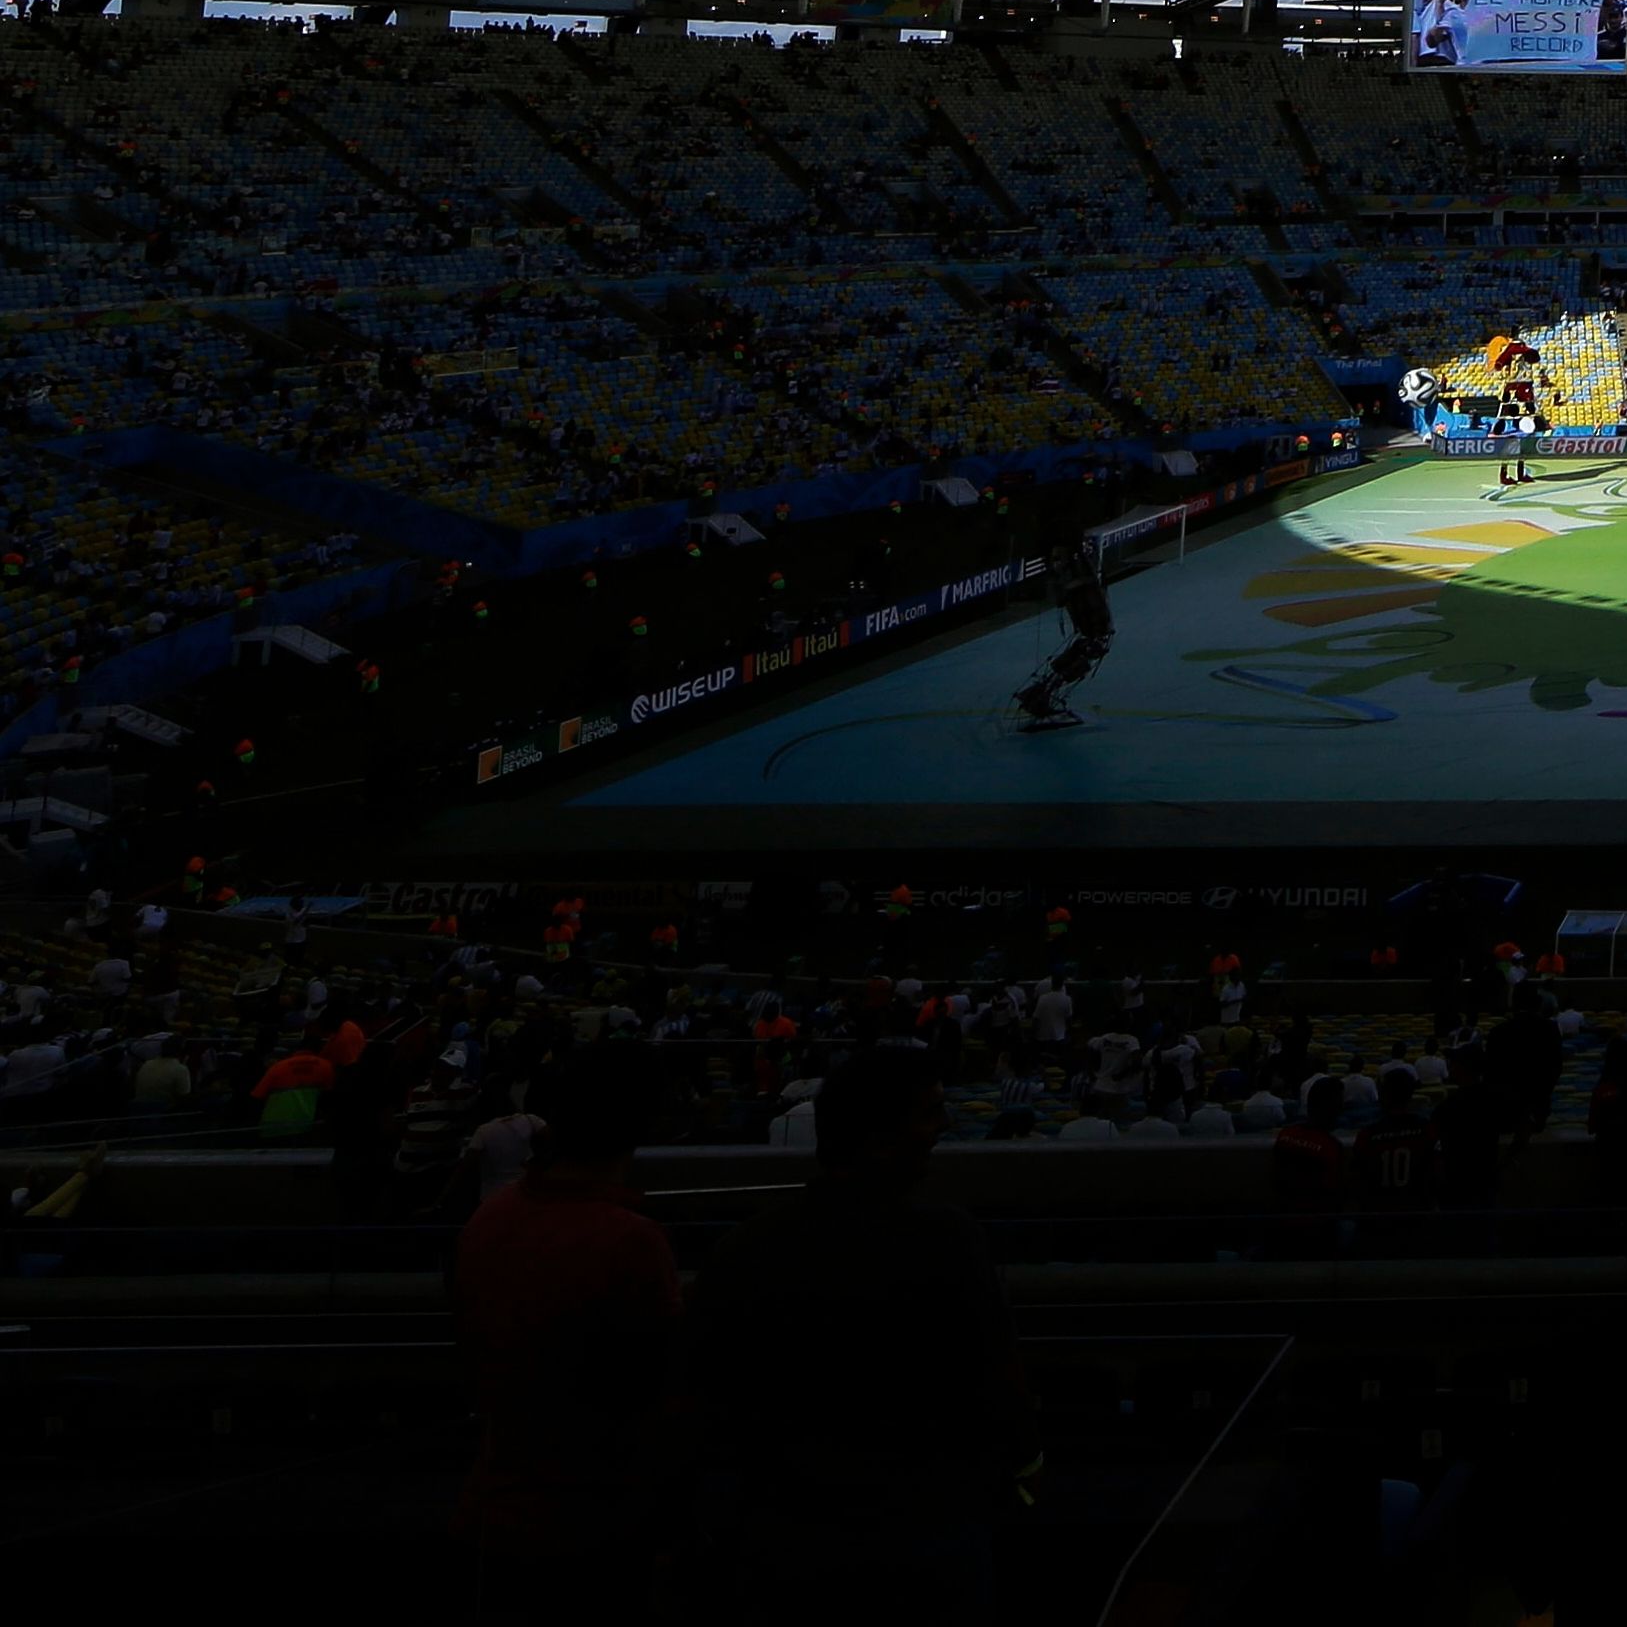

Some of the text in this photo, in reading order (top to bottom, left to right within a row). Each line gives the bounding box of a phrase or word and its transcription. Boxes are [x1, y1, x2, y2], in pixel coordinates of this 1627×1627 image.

[1511, 37, 1583, 53] RECORD
[1553, 437, 1622, 454] Castrol
[952, 564, 1013, 604] MARFRIG
[1077, 890, 1193, 904] POWERADE
[1380, 1147, 1411, 1188] 10
